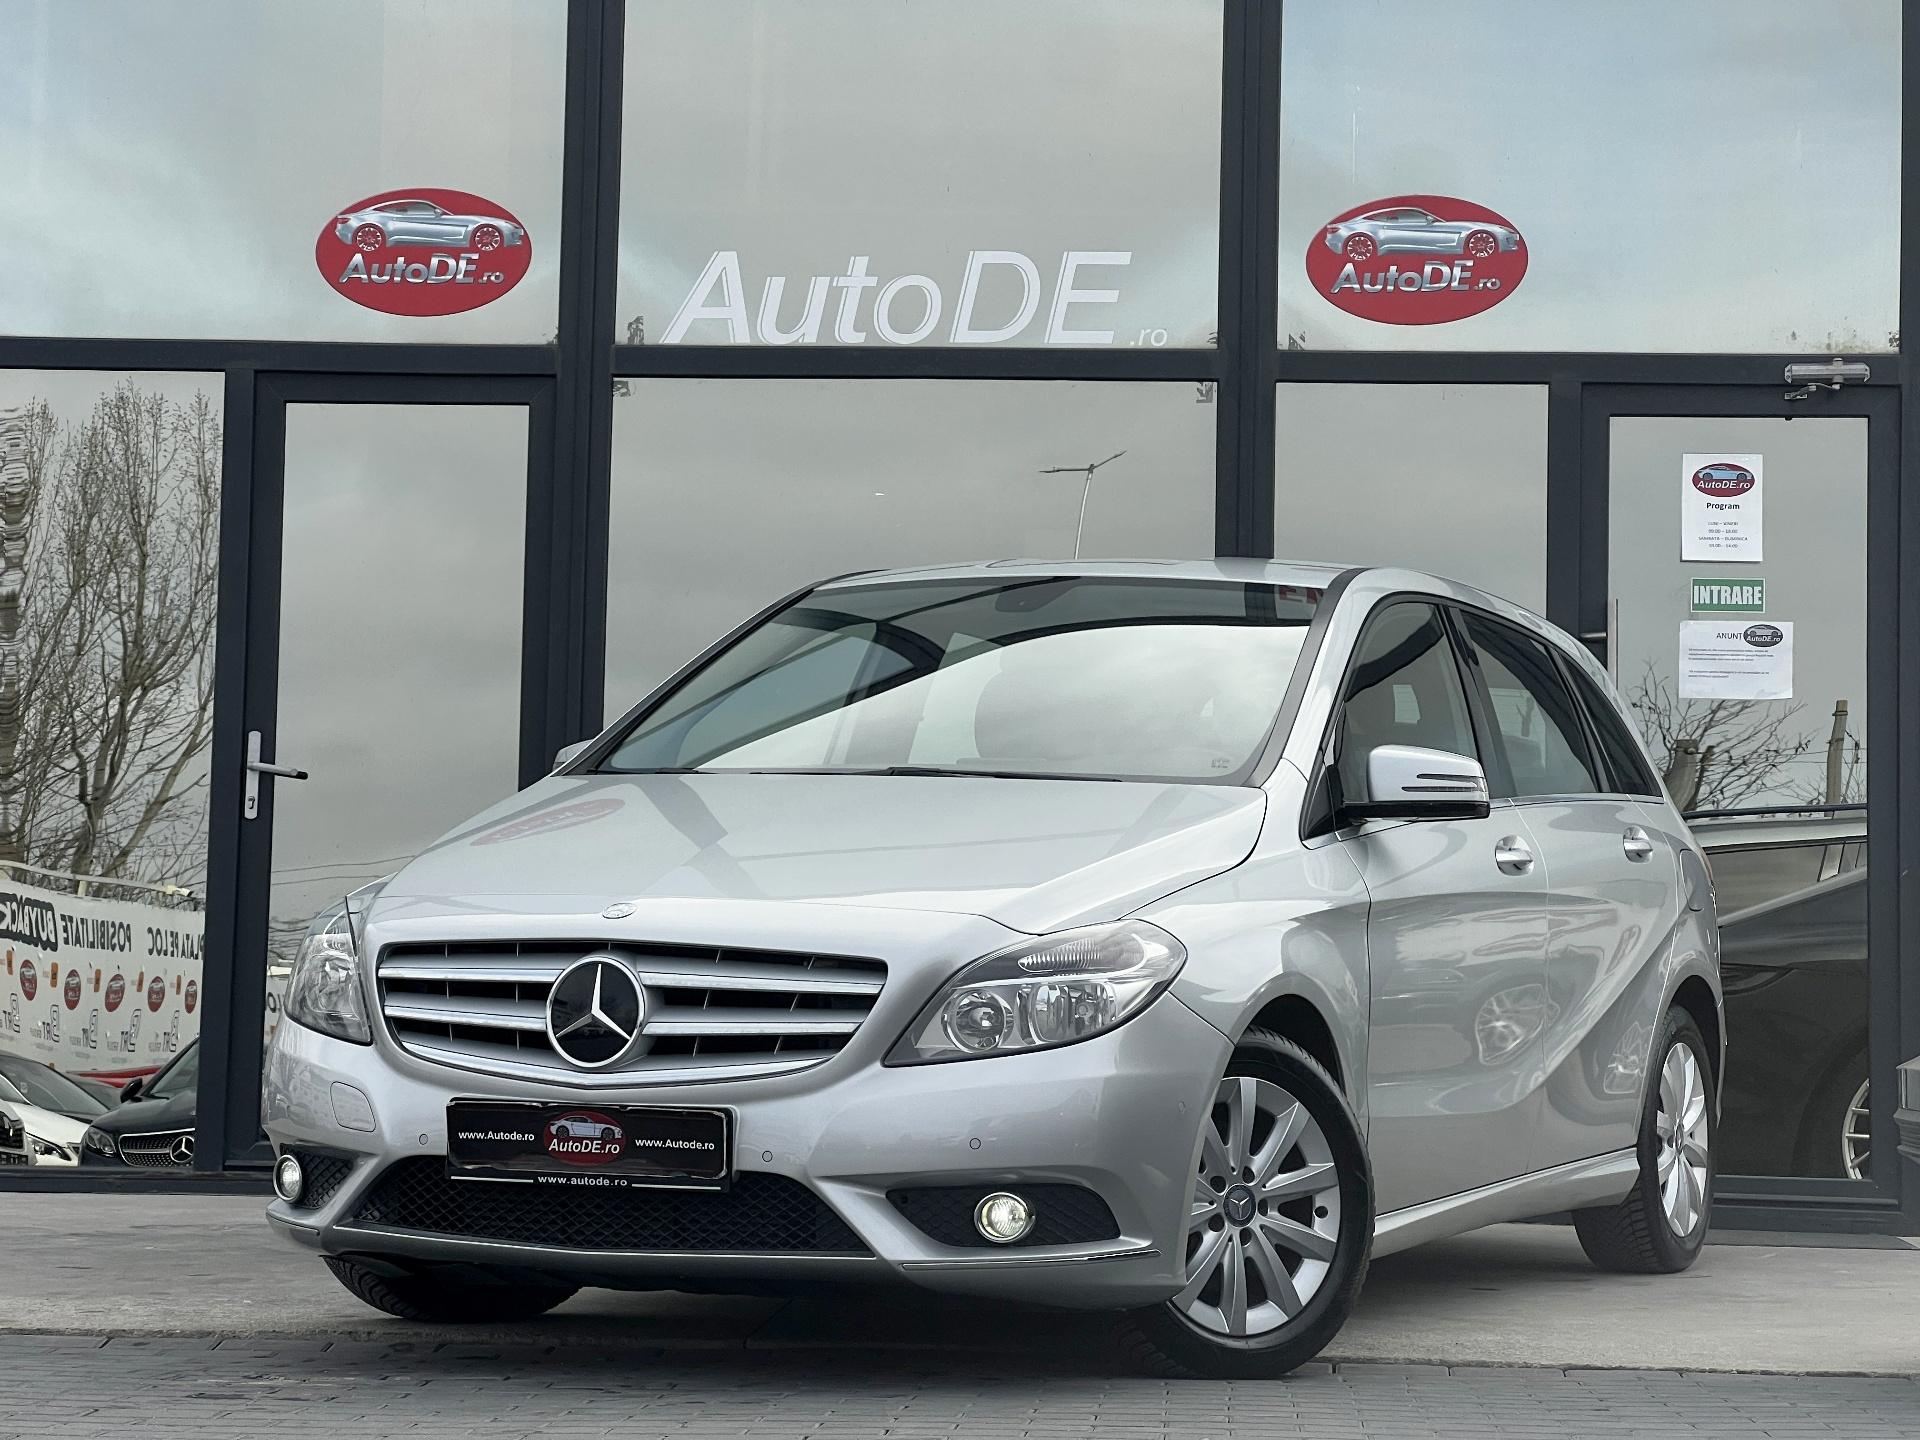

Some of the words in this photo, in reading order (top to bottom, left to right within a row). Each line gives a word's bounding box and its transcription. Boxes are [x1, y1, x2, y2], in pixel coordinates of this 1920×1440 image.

[1697, 480, 1751, 489] AutoDE.ro
[1706, 502, 1740, 511] Program
[1693, 585, 1762, 605] INTRARE
[1716, 632, 1742, 641] ANUNT
[1746, 635, 1781, 643] AutoDE.ro
[457, 1129, 535, 1142] www.Autode.ro
[548, 1138, 620, 1155] AutoDE.ro
[634, 1137, 715, 1151] www.Autode.ro
[537, 1175, 628, 1188] www.autode.ro
